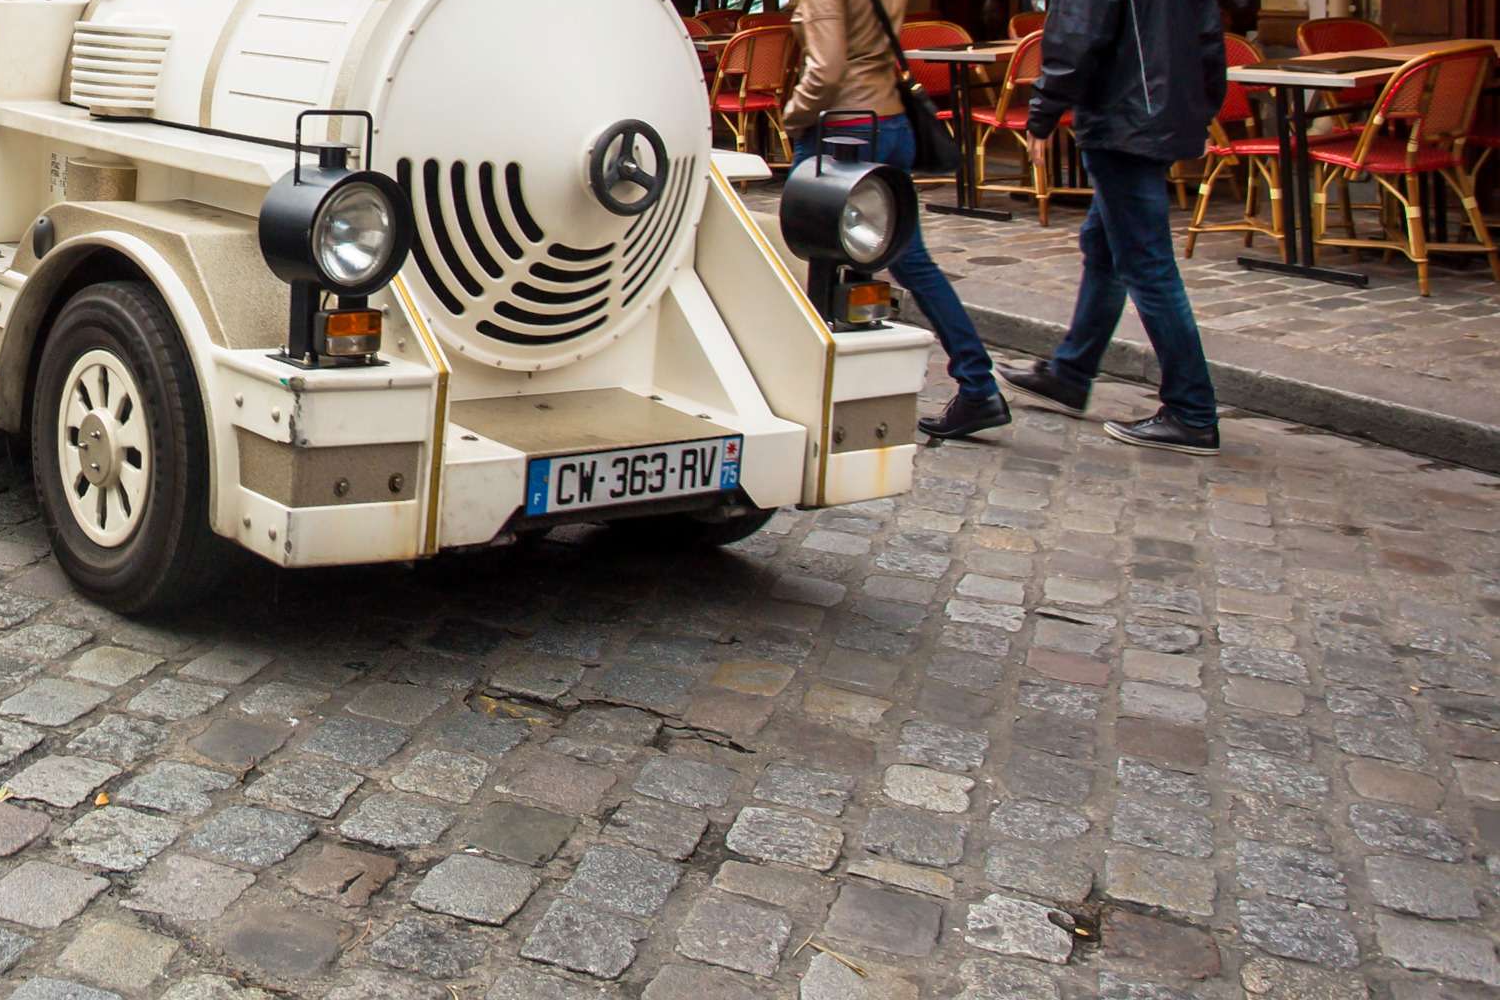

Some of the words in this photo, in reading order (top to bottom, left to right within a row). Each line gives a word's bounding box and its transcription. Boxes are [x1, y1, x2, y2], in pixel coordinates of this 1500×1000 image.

[556, 446, 718, 506] CW-363-RV
[721, 464, 738, 485] 75
[533, 492, 542, 506] F
